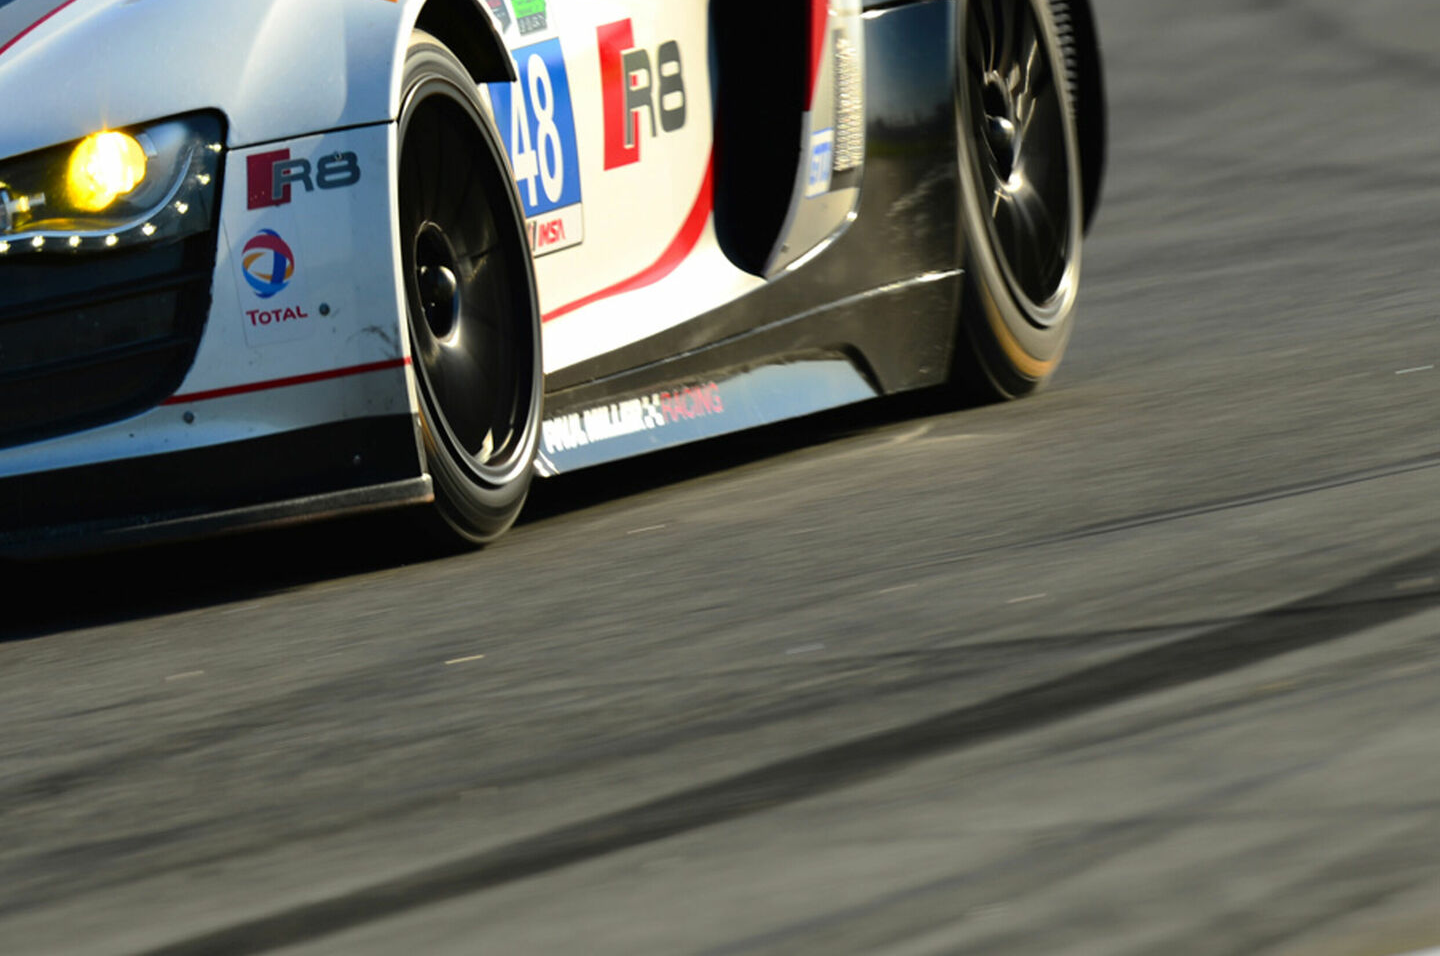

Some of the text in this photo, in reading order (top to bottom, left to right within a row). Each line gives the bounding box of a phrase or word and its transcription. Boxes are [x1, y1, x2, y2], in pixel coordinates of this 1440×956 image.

[622, 40, 687, 149] R8
[510, 54, 564, 208] 48
[272, 151, 361, 200] R8
[246, 306, 308, 326] TOTAL
[660, 381, 724, 423] RACING
